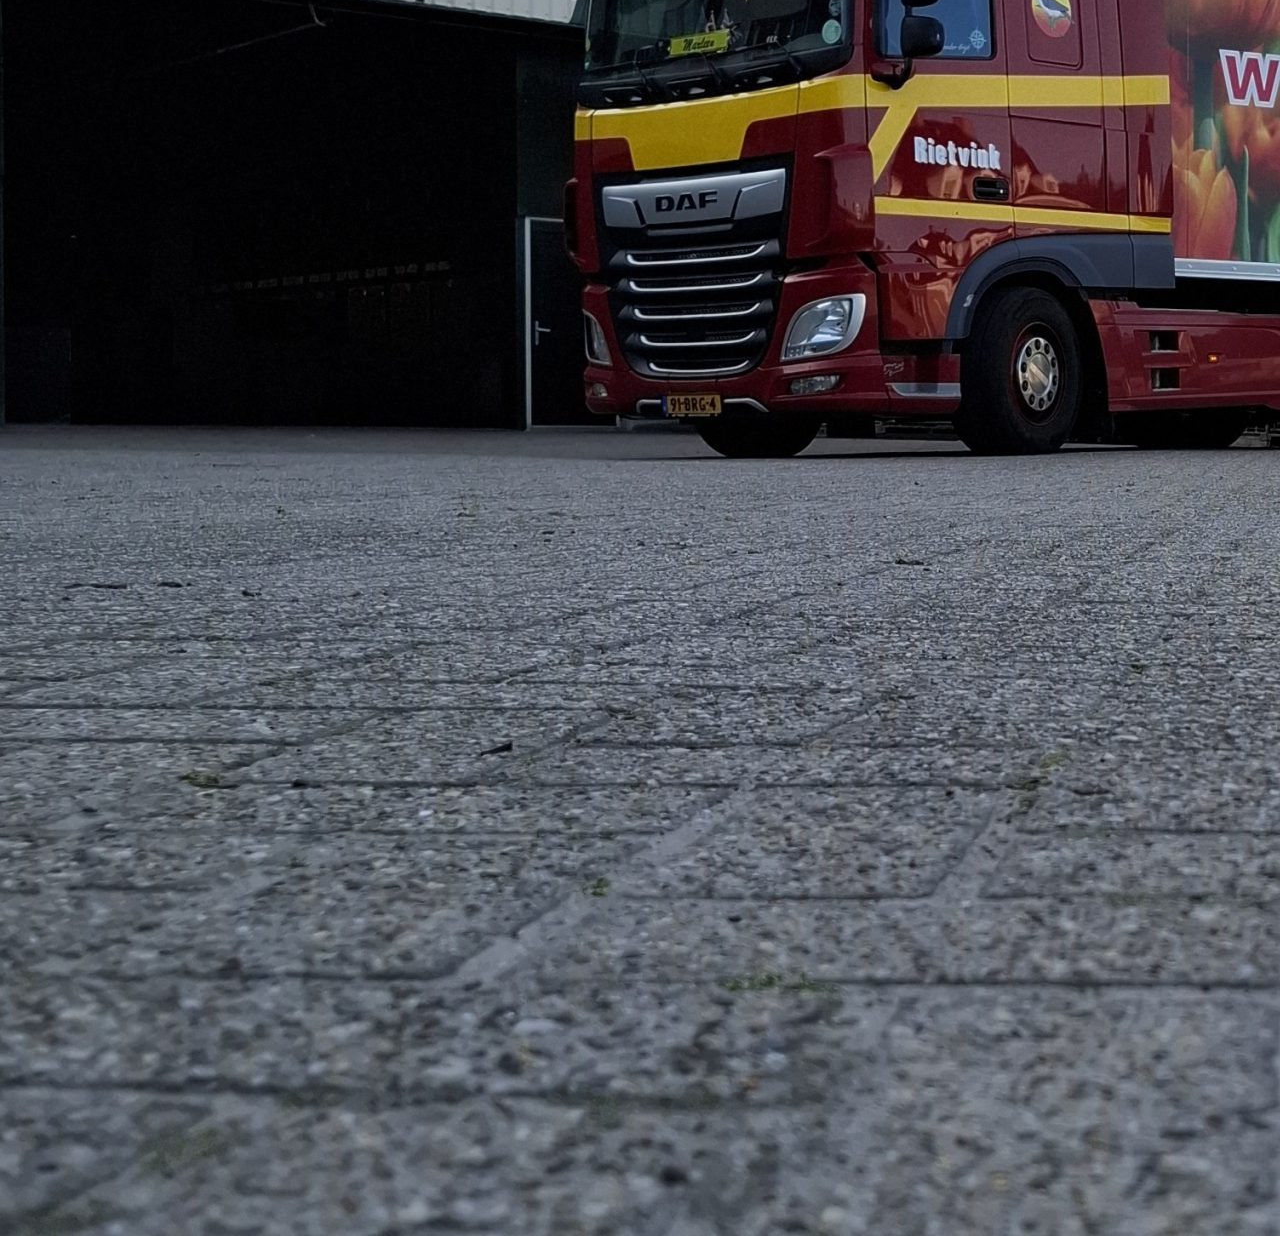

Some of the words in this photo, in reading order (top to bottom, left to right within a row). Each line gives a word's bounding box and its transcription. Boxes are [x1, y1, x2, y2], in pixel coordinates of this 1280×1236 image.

[913, 135, 1001, 171] Rietvink
[655, 190, 718, 213] DAF
[670, 396, 717, 413] 91-BRG-4
